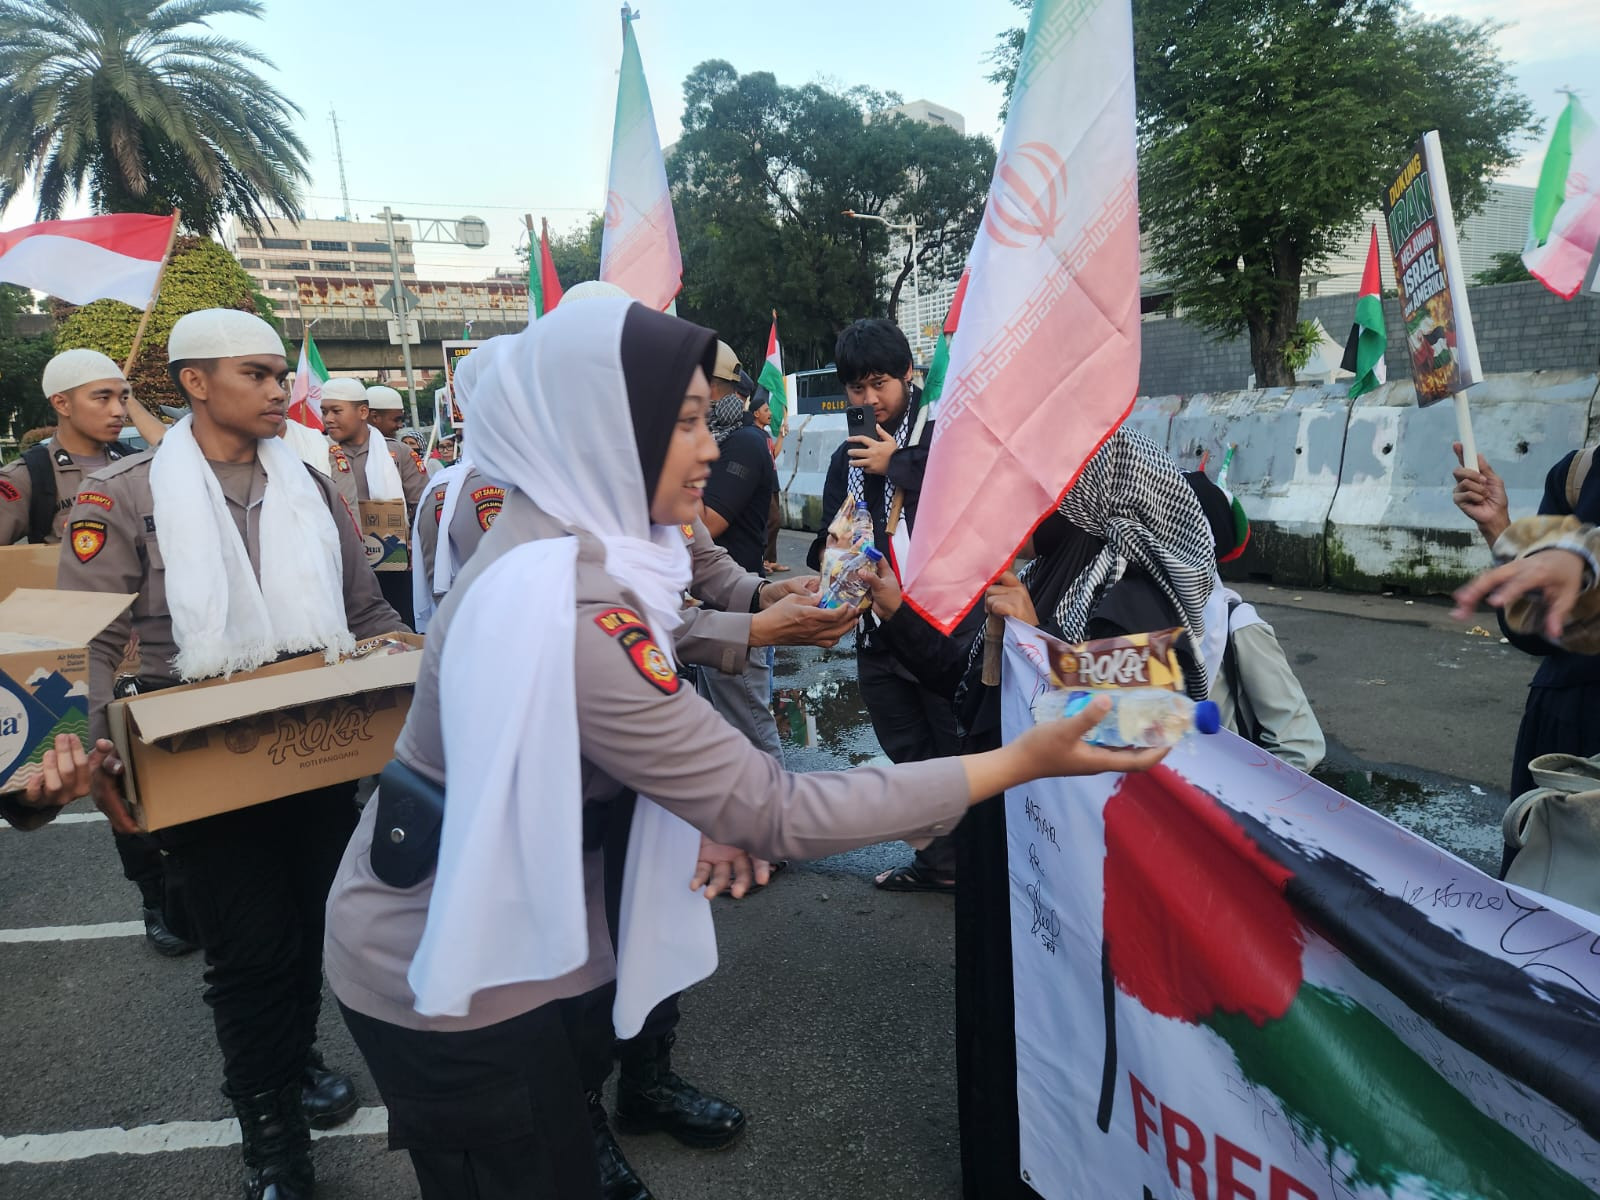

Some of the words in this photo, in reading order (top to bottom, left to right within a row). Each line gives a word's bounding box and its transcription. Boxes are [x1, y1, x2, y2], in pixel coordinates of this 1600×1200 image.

[1389, 153, 1422, 207] DUKUNG
[1388, 171, 1434, 257] IRAN
[1401, 225, 1434, 269] MELAWAN
[1402, 248, 1440, 298] ISRAEL
[1412, 271, 1446, 311] AMERIKA
[821, 401, 847, 410] POLIS
[1079, 647, 1150, 684] AOKA
[268, 704, 375, 766] AOKA
